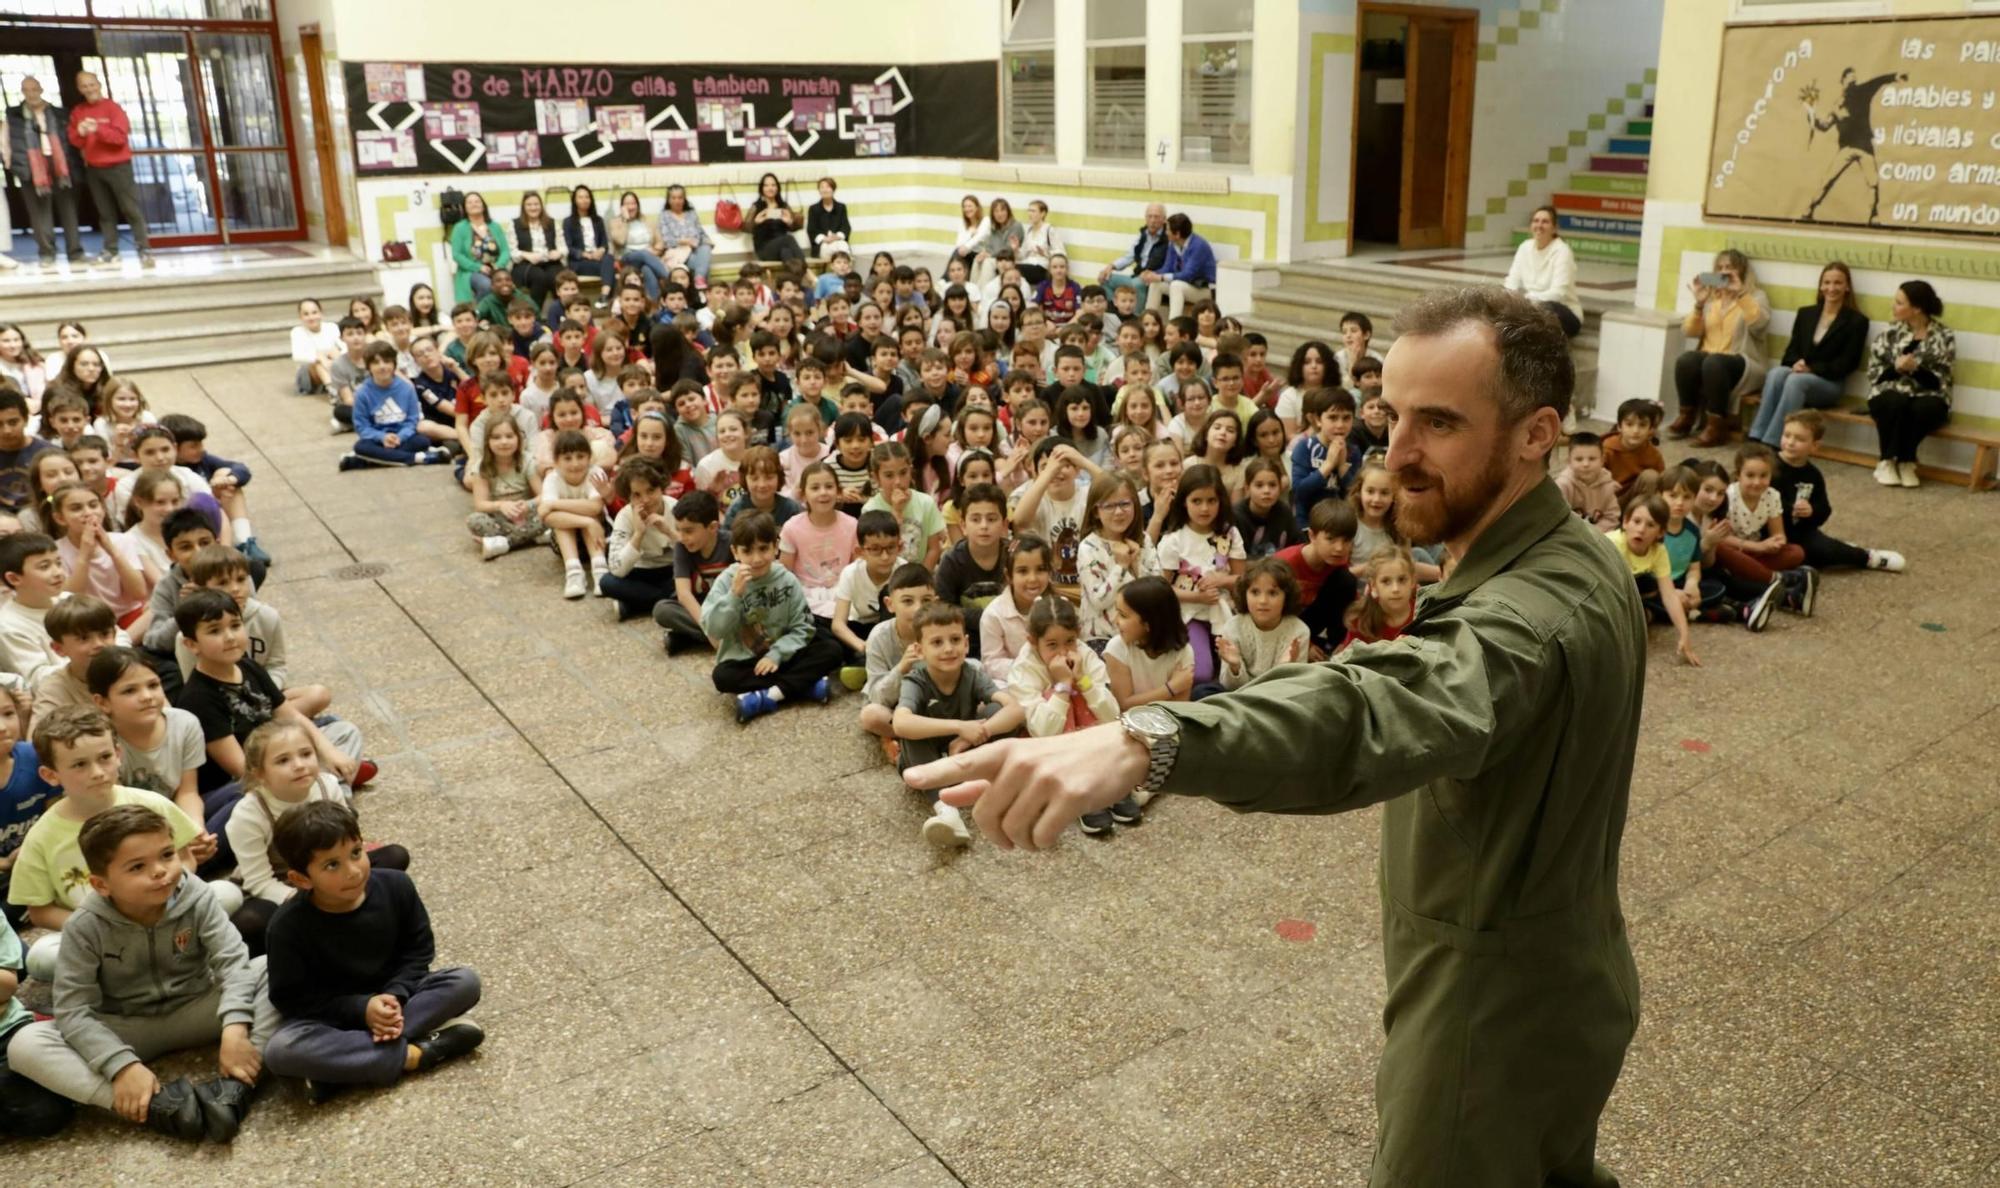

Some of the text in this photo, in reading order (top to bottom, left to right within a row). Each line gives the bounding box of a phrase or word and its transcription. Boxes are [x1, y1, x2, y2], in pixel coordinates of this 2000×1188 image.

[1901, 38, 1936, 60] las
[451, 68, 473, 99] 8
[482, 75, 510, 97] de
[519, 68, 613, 98] MARZO
[631, 75, 677, 97] ellas
[1881, 85, 1995, 110] amables y
[1713, 39, 1813, 189] selecciona
[1873, 127, 1886, 146] y
[1893, 119, 1974, 148] llévalas
[1879, 161, 1936, 181] como
[1892, 203, 1999, 225] un mundo
